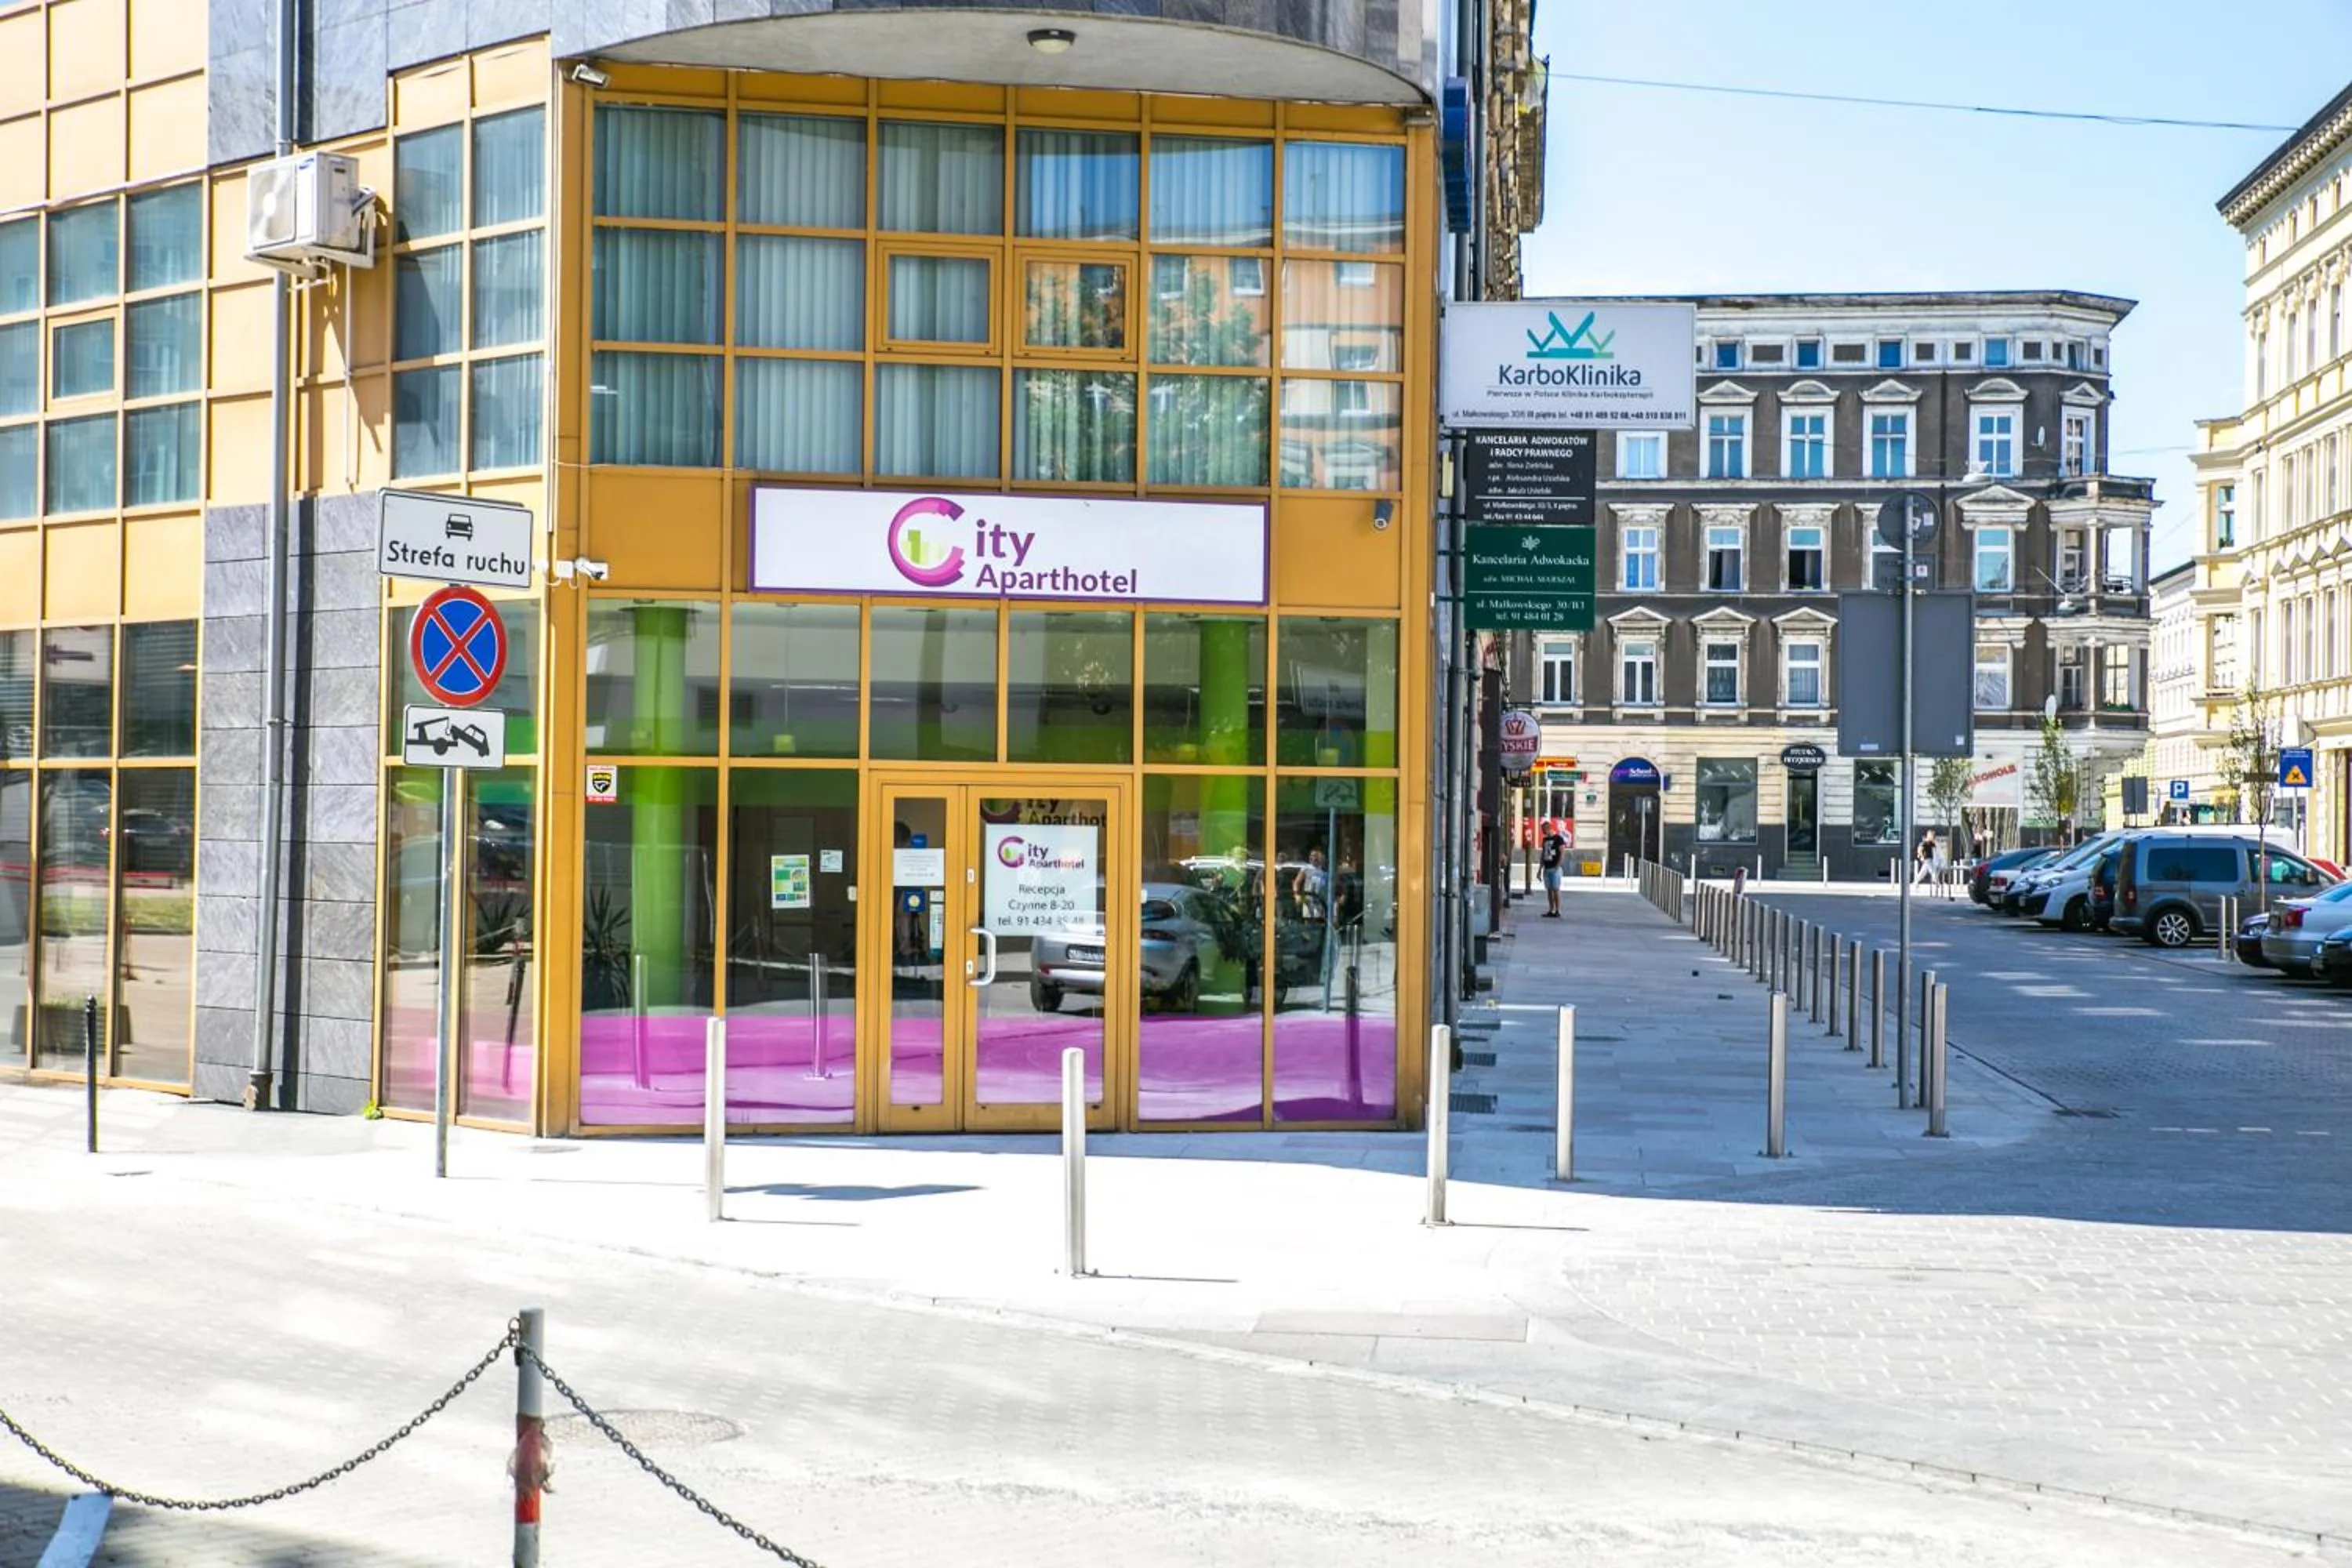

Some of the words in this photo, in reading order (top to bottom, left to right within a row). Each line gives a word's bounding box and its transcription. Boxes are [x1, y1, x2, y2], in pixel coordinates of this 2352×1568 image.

[1498, 363, 1642, 386] KarboKlinika
[1475, 435, 1527, 445] KANCELARIA
[1494, 448, 1523, 457] RADCY
[1525, 448, 1573, 458] PRAWNEGO
[387, 540, 456, 568] Strefa
[466, 552, 525, 575] ruchu
[1472, 554, 1526, 565] Kancelaria
[1530, 554, 1590, 565] Adwokacka
[975, 564, 1138, 594] Aparthotel
[1501, 739, 1535, 751] YSKIE
[2173, 782, 2185, 797] P
[1028, 858, 1084, 869] Aparthotel
[1018, 884, 1065, 895] Recepcja
[1007, 899, 1047, 913] Czynne
[1050, 899, 1075, 910] 8-20
[998, 916, 1012, 926] tel.
